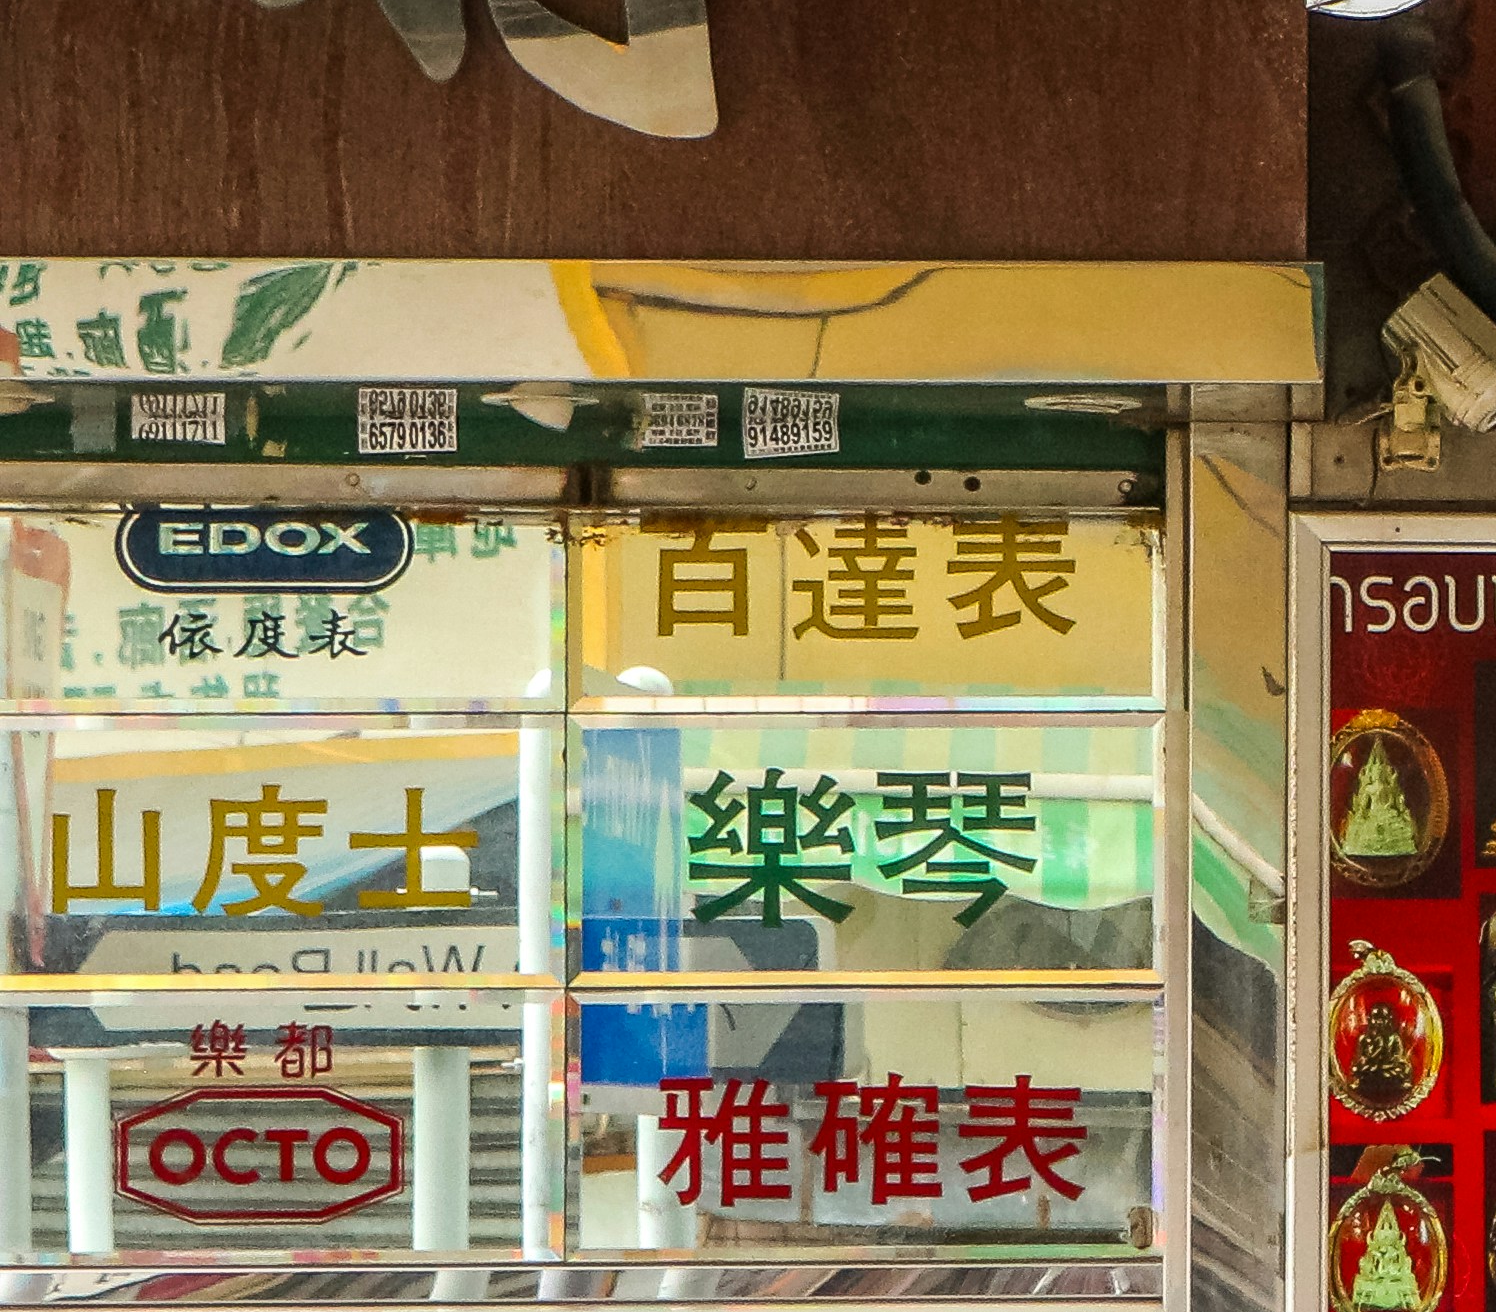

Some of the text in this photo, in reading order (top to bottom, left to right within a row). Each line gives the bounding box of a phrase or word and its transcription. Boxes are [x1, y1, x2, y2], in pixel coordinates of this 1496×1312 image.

[157, 522, 373, 557] EDOX
[638, 512, 1077, 641] 百達表
[157, 609, 370, 661] 依度表
[50, 784, 481, 917] 山度士
[687, 767, 1038, 930] 樂琴
[189, 1020, 334, 1080] 樂都
[148, 1127, 372, 1185] OCTO
[656, 1071, 1089, 1208] 雅確表
